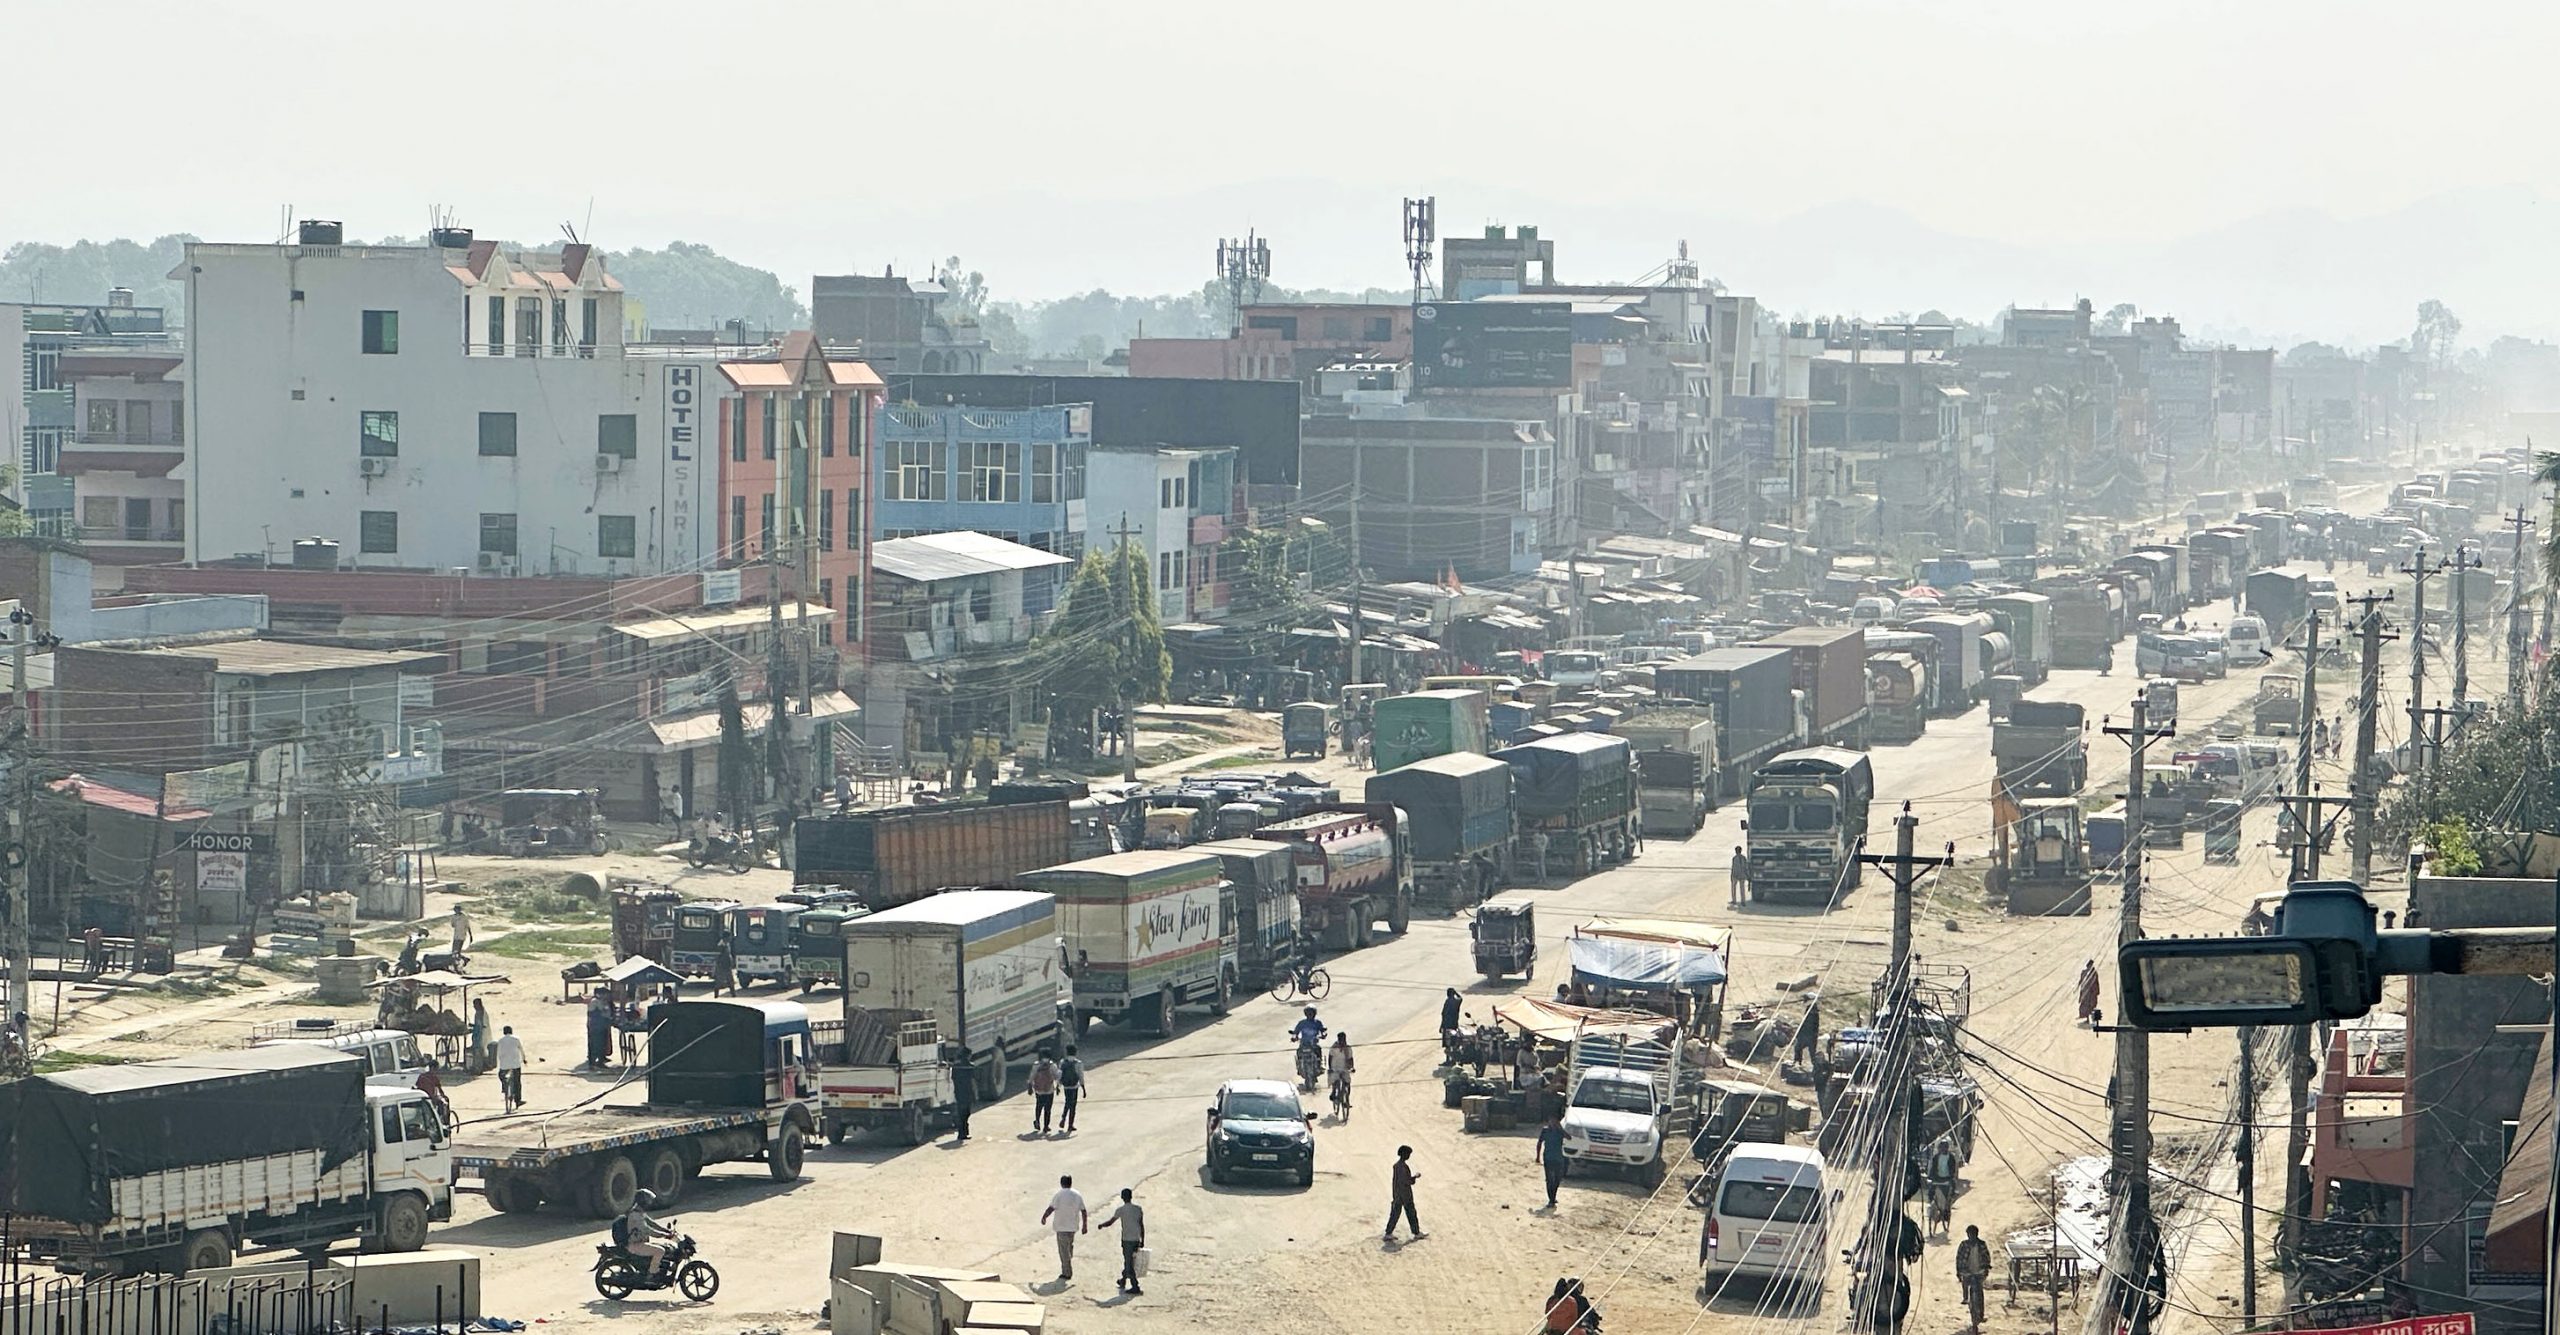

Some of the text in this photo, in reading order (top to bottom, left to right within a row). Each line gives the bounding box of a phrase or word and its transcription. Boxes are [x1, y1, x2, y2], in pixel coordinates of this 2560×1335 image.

[671, 368, 692, 461] HOTEL
[191, 834, 253, 851] HONOR
[1149, 903, 1174, 945] Star
